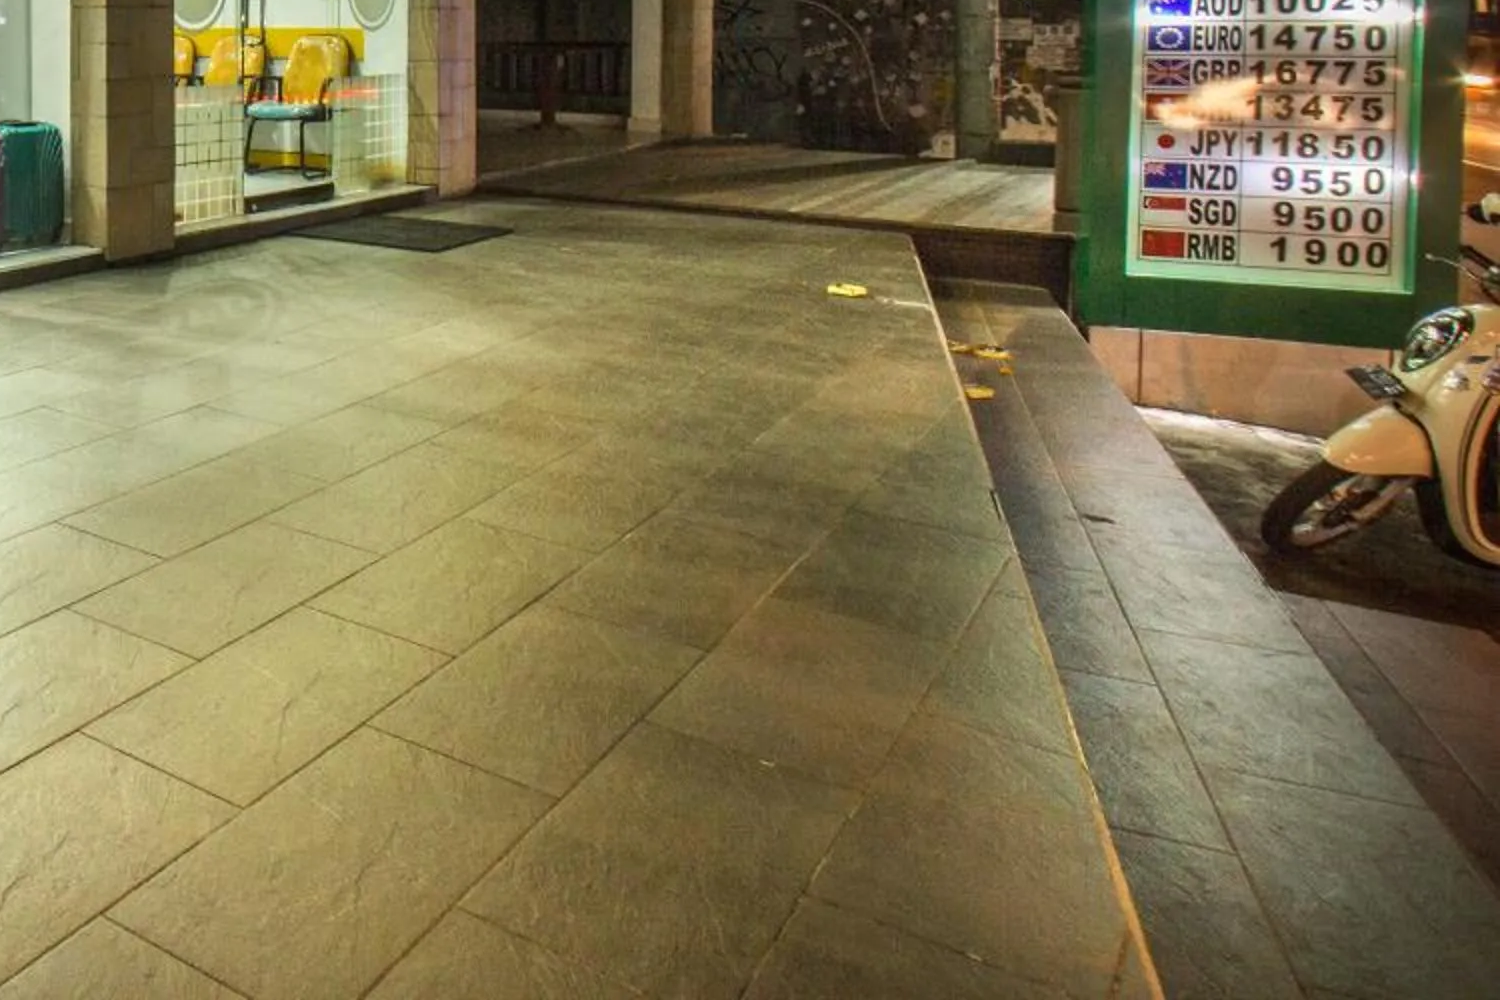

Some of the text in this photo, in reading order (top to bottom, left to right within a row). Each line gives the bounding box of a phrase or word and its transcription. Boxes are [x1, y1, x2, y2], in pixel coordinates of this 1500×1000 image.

[1193, 24, 1387, 52] EURO 14750
[1249, 60, 1386, 85] 16775
[1246, 95, 1384, 122] 13475
[1190, 130, 1238, 157] JPY
[1189, 165, 1386, 197] NZD 9550
[1188, 200, 1384, 234] SGD 9500
[1187, 234, 1388, 267] RMB 1900
